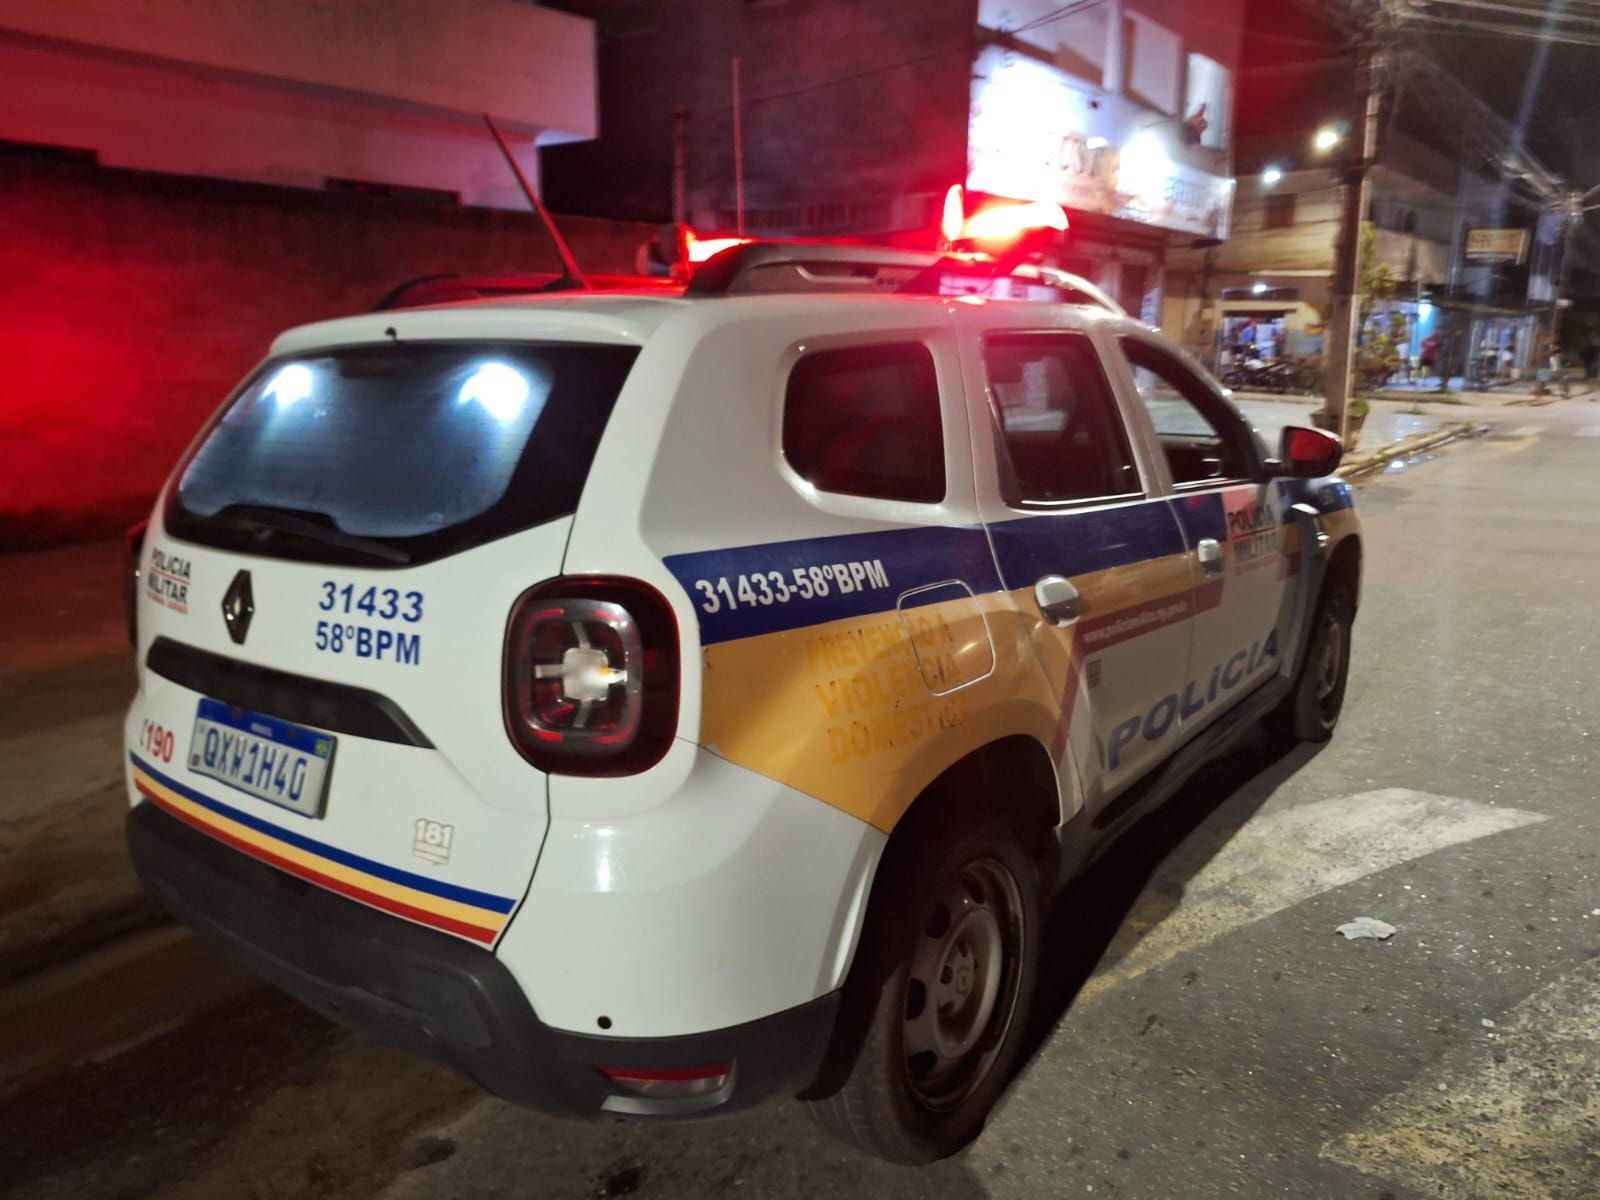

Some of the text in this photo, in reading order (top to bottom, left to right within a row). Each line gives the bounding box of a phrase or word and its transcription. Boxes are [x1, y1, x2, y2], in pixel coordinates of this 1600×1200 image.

[319, 580, 424, 623] 31433
[146, 722, 174, 764] 190
[203, 727, 307, 801] QXW1H40
[413, 817, 454, 849] 181
